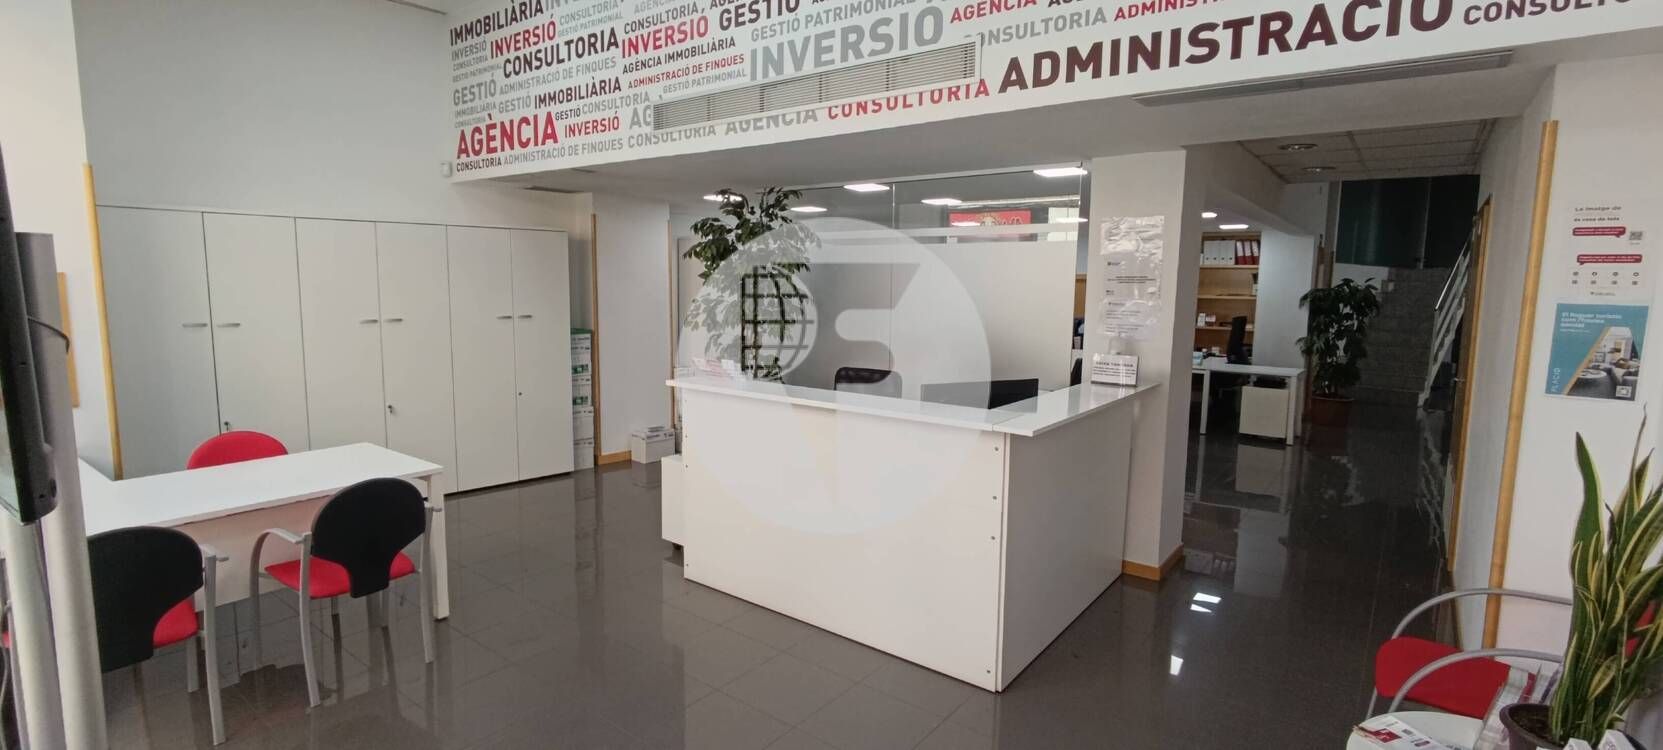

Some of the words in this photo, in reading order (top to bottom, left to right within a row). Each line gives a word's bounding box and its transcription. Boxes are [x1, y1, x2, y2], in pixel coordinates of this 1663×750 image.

[490, 14, 556, 59] INVERSIÓ
[503, 27, 619, 79] CONSULTORIA
[692, 64, 704, 75] DE
[705, 53, 745, 71] FINQUES
[562, 68, 574, 80] DE
[576, 56, 617, 76] FINQUES
[691, 68, 748, 88] PATRIMONIAL
[453, 72, 497, 107] GESTIÓ
[534, 75, 622, 110] IMMOBILIÀRIA
[499, 91, 532, 114] GESTIÓ
[582, 91, 650, 115] CONSULTORIA
[456, 111, 558, 160] AGÈNCIA
[564, 110, 620, 139] INVERSIÓ
[568, 144, 580, 156] DE
[581, 137, 624, 155] FINQUES
[456, 157, 502, 172] CONSULTORIA
